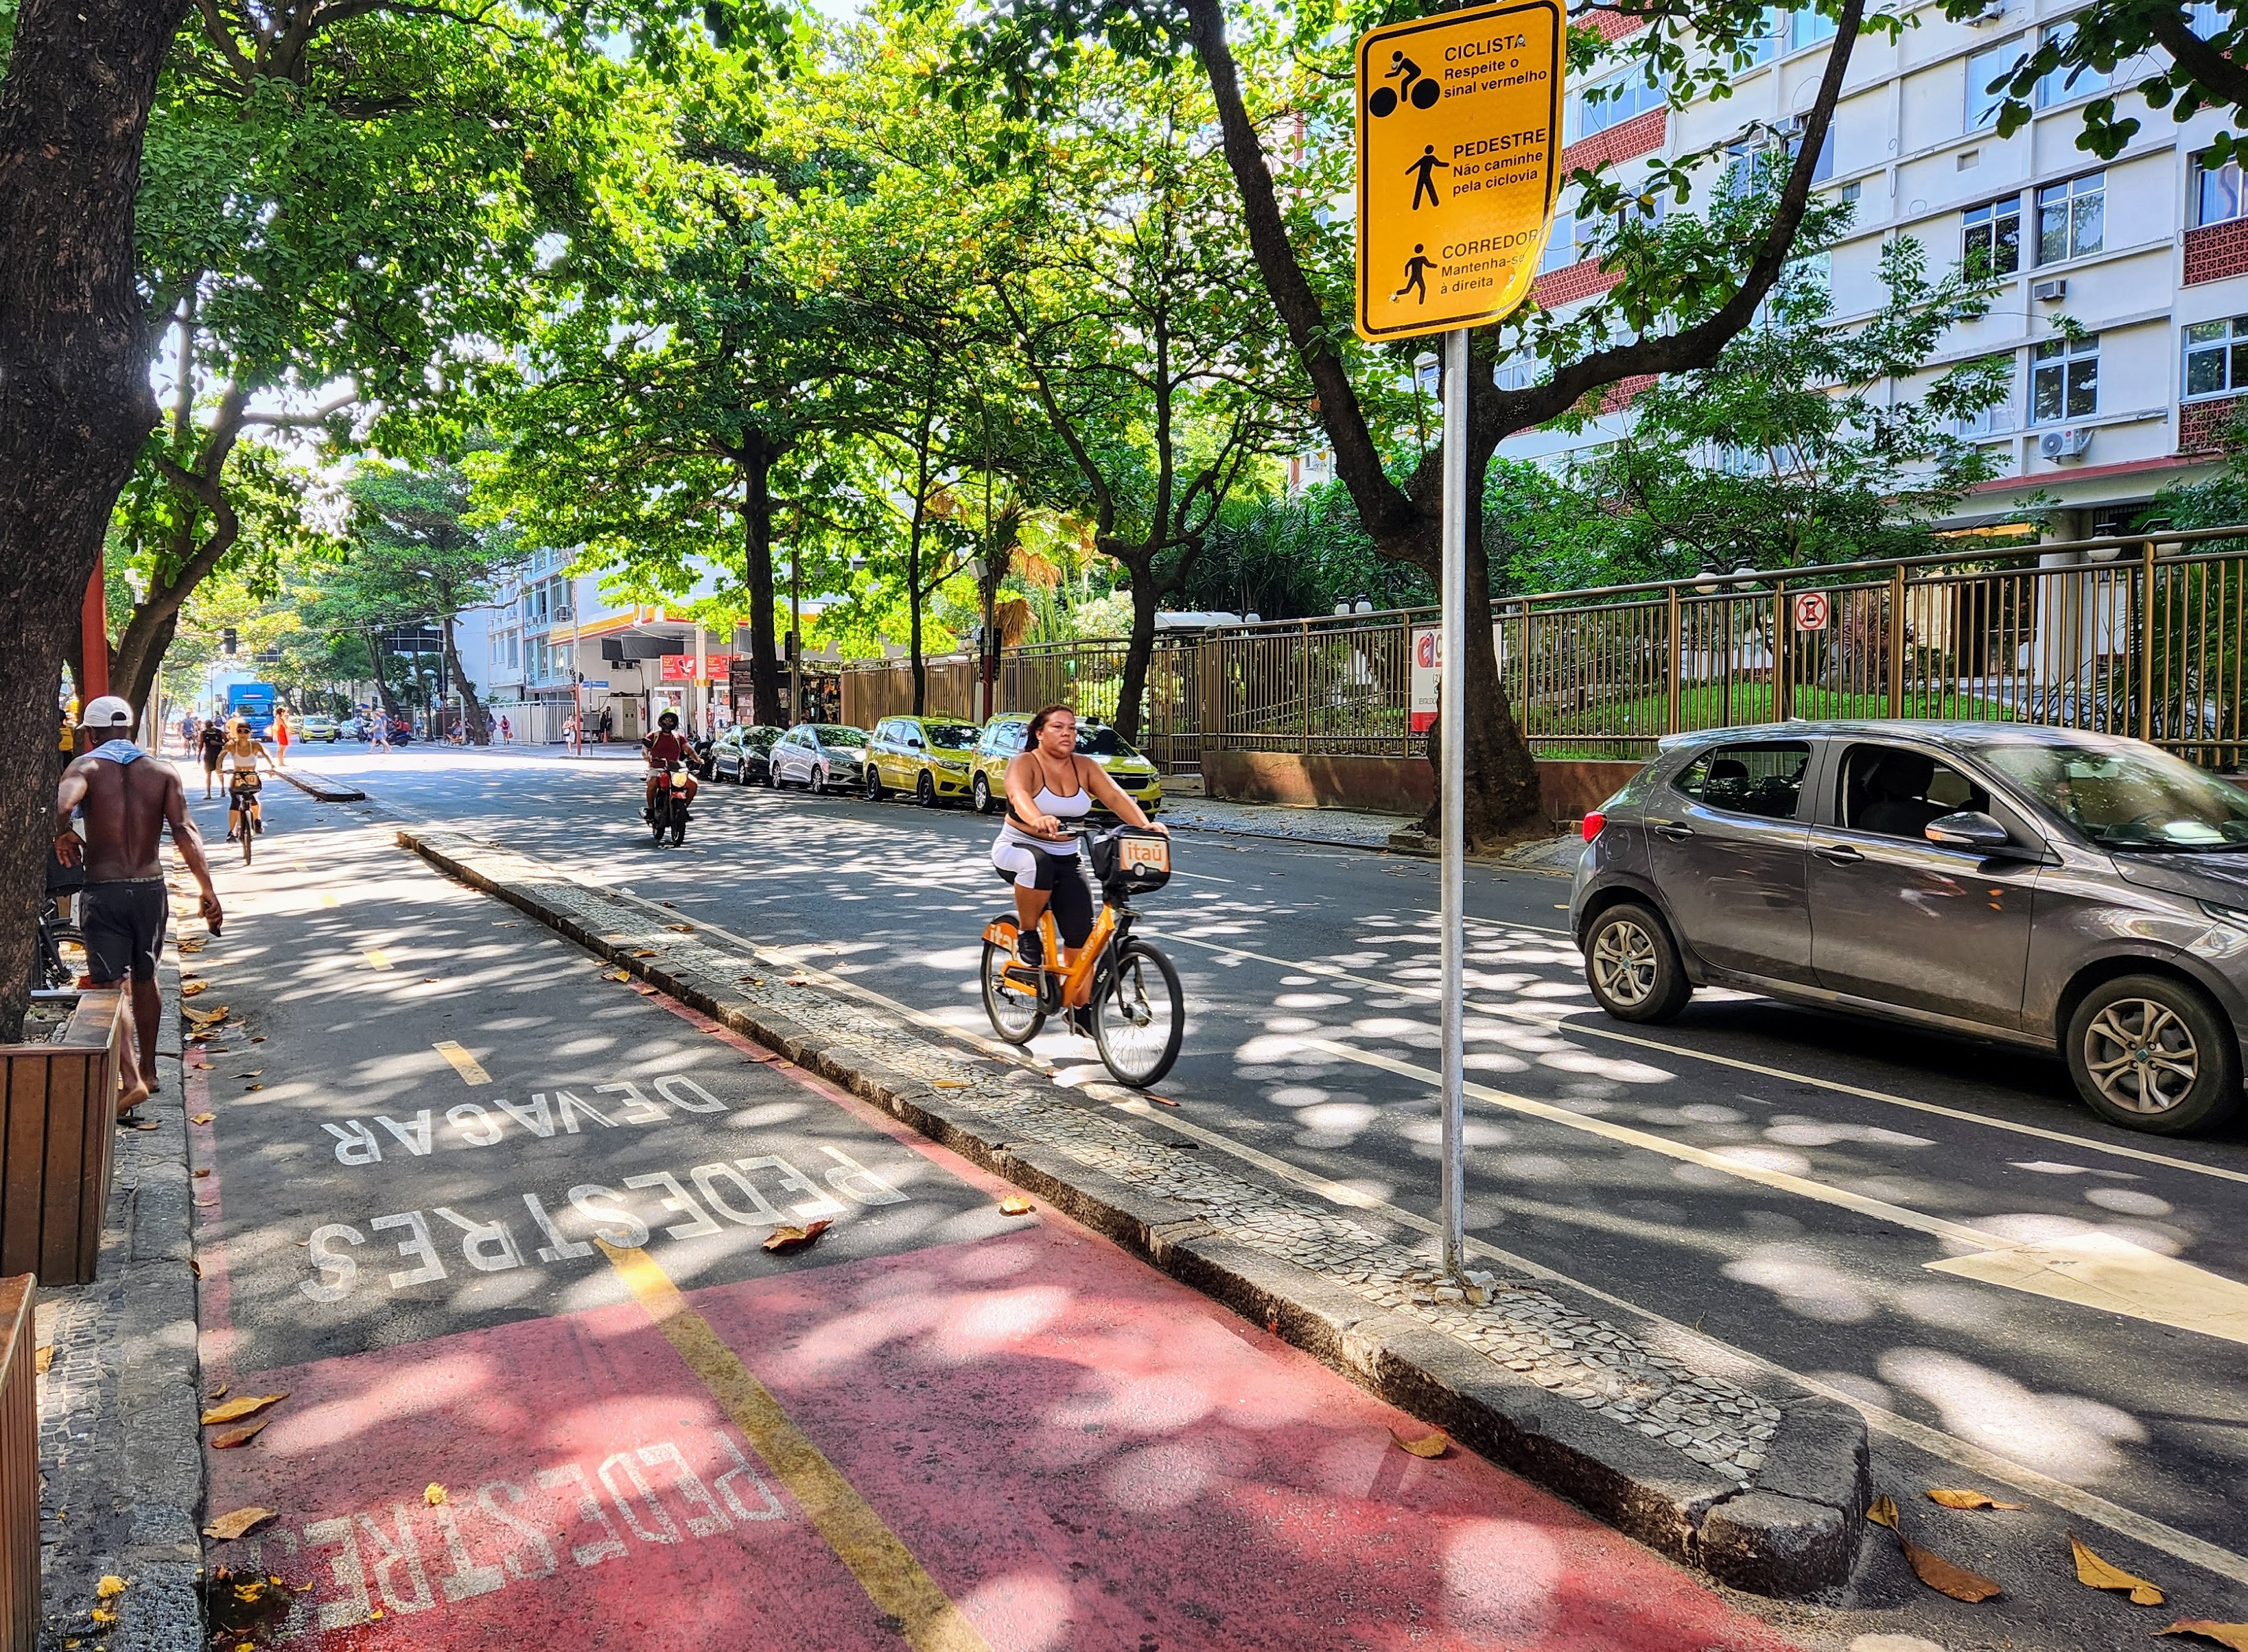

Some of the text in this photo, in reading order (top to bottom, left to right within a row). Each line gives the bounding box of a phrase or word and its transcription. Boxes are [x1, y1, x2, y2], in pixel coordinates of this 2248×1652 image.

[1444, 34, 1526, 62] CICLISTA
[1444, 58, 1519, 80] Respeite o
[1444, 70, 1547, 98] sinal vermelho
[1453, 128, 1547, 159] PEDESTRE
[1453, 152, 1543, 177] Não caminhe
[1453, 169, 1537, 198] pela ciclovia
[1442, 229, 1538, 259] CORREDOR
[1441, 253, 1525, 277] Mantenha-se
[1440, 276, 1493, 294] à direita
[1127, 841, 1163, 862] itaú
[320, 1073, 729, 1166] DEVAGAR
[298, 1145, 911, 1303] PEDESTRES
